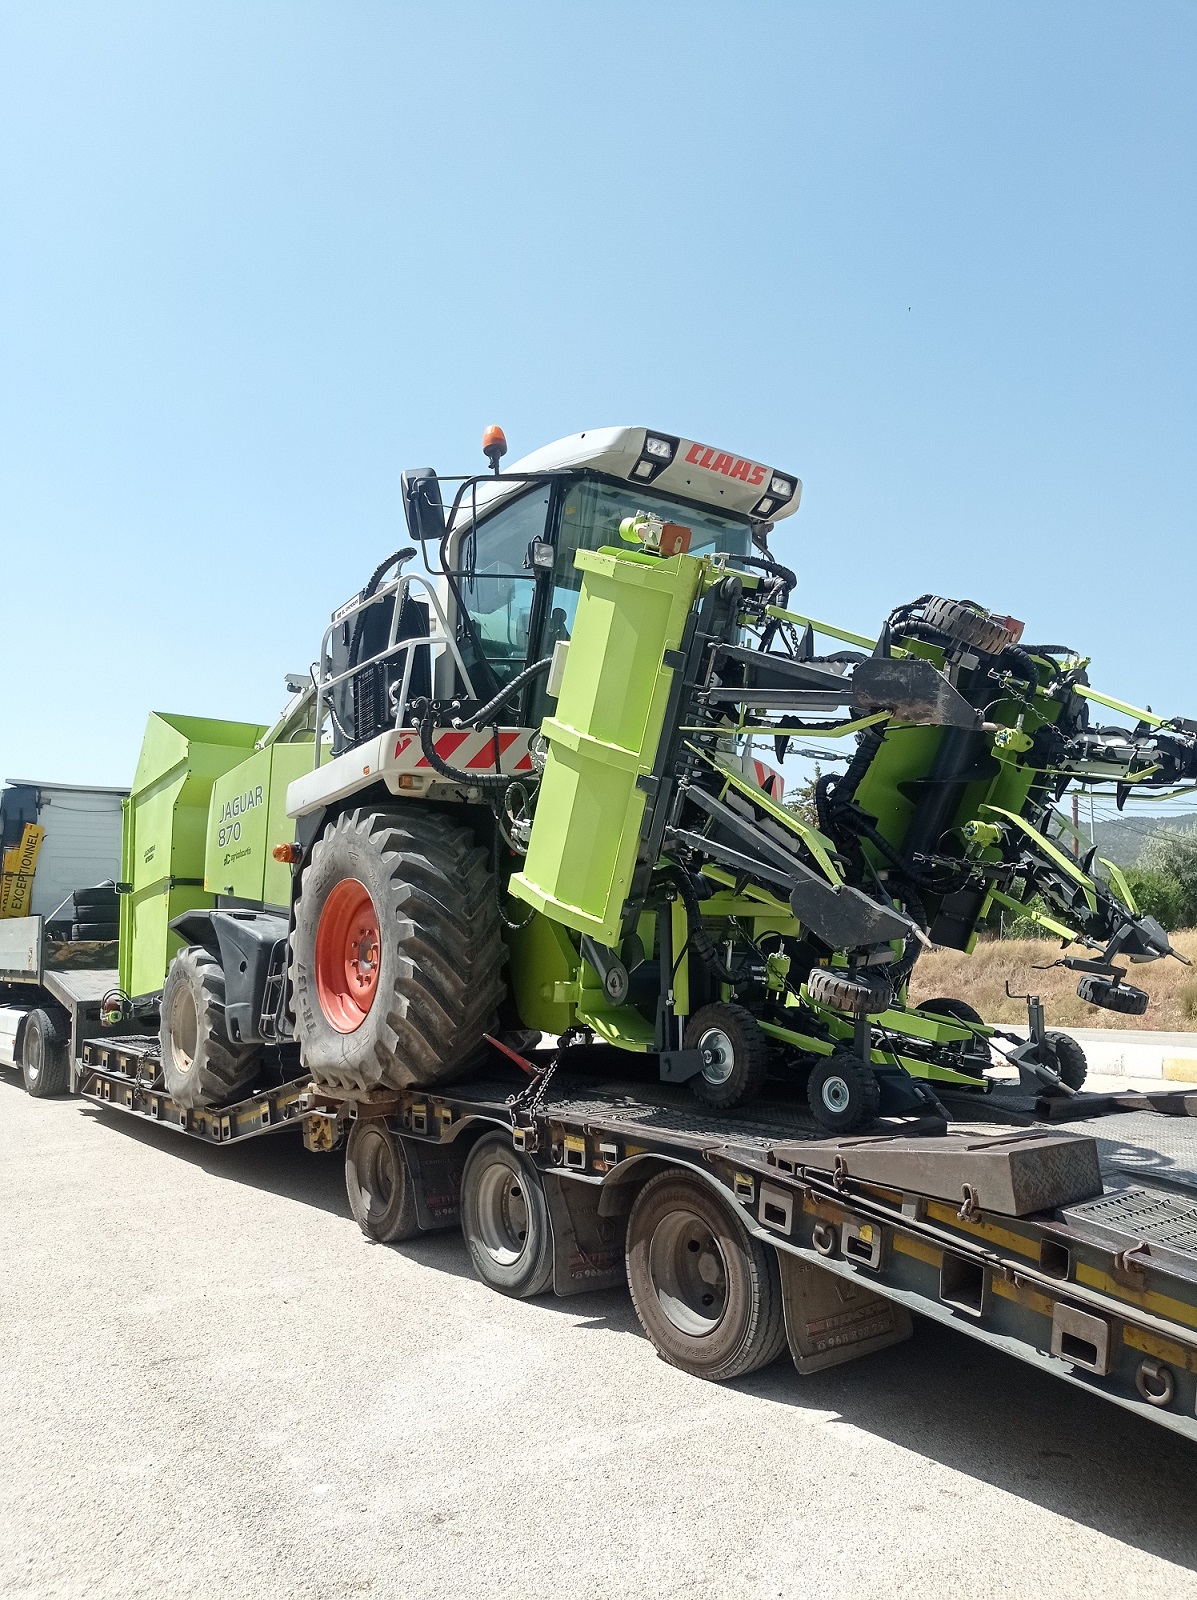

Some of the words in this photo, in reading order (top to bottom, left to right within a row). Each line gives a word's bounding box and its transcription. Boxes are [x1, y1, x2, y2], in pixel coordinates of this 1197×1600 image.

[685, 443, 767, 486] CLAAS
[219, 785, 263, 823] JAGUAR
[218, 822, 241, 847] 870
[11, 832, 39, 910] EXCEPTIONNEL
[297, 962, 317, 1035] TR-137
[828, 1333, 849, 1347] 968
